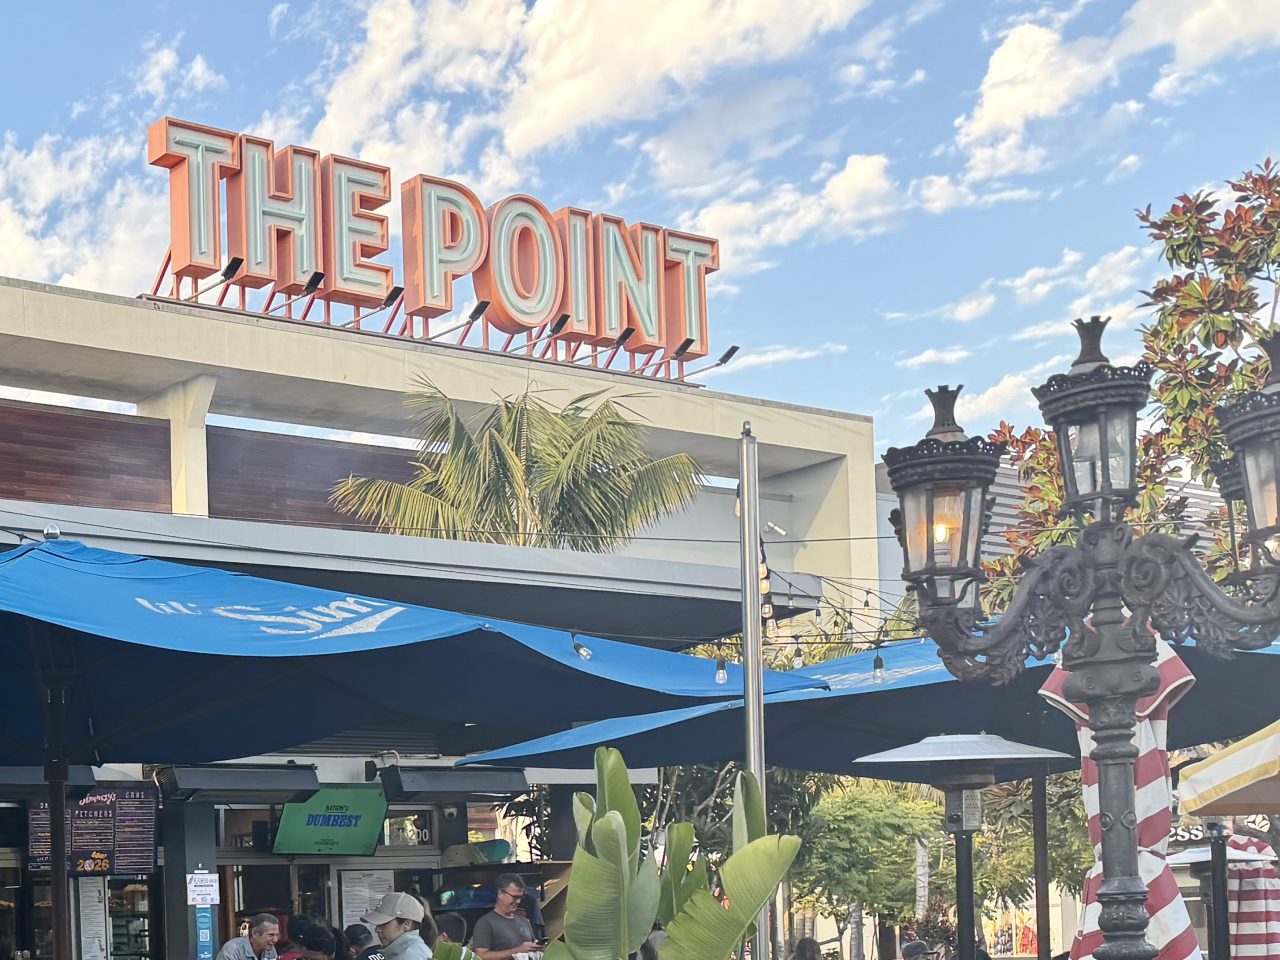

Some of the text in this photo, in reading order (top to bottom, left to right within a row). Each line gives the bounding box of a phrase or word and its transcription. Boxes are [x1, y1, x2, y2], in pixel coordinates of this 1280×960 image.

[147, 116, 720, 362] THE POINT
[74, 810, 113, 818] PITCHERS
[306, 813, 362, 828] DUMBEST
